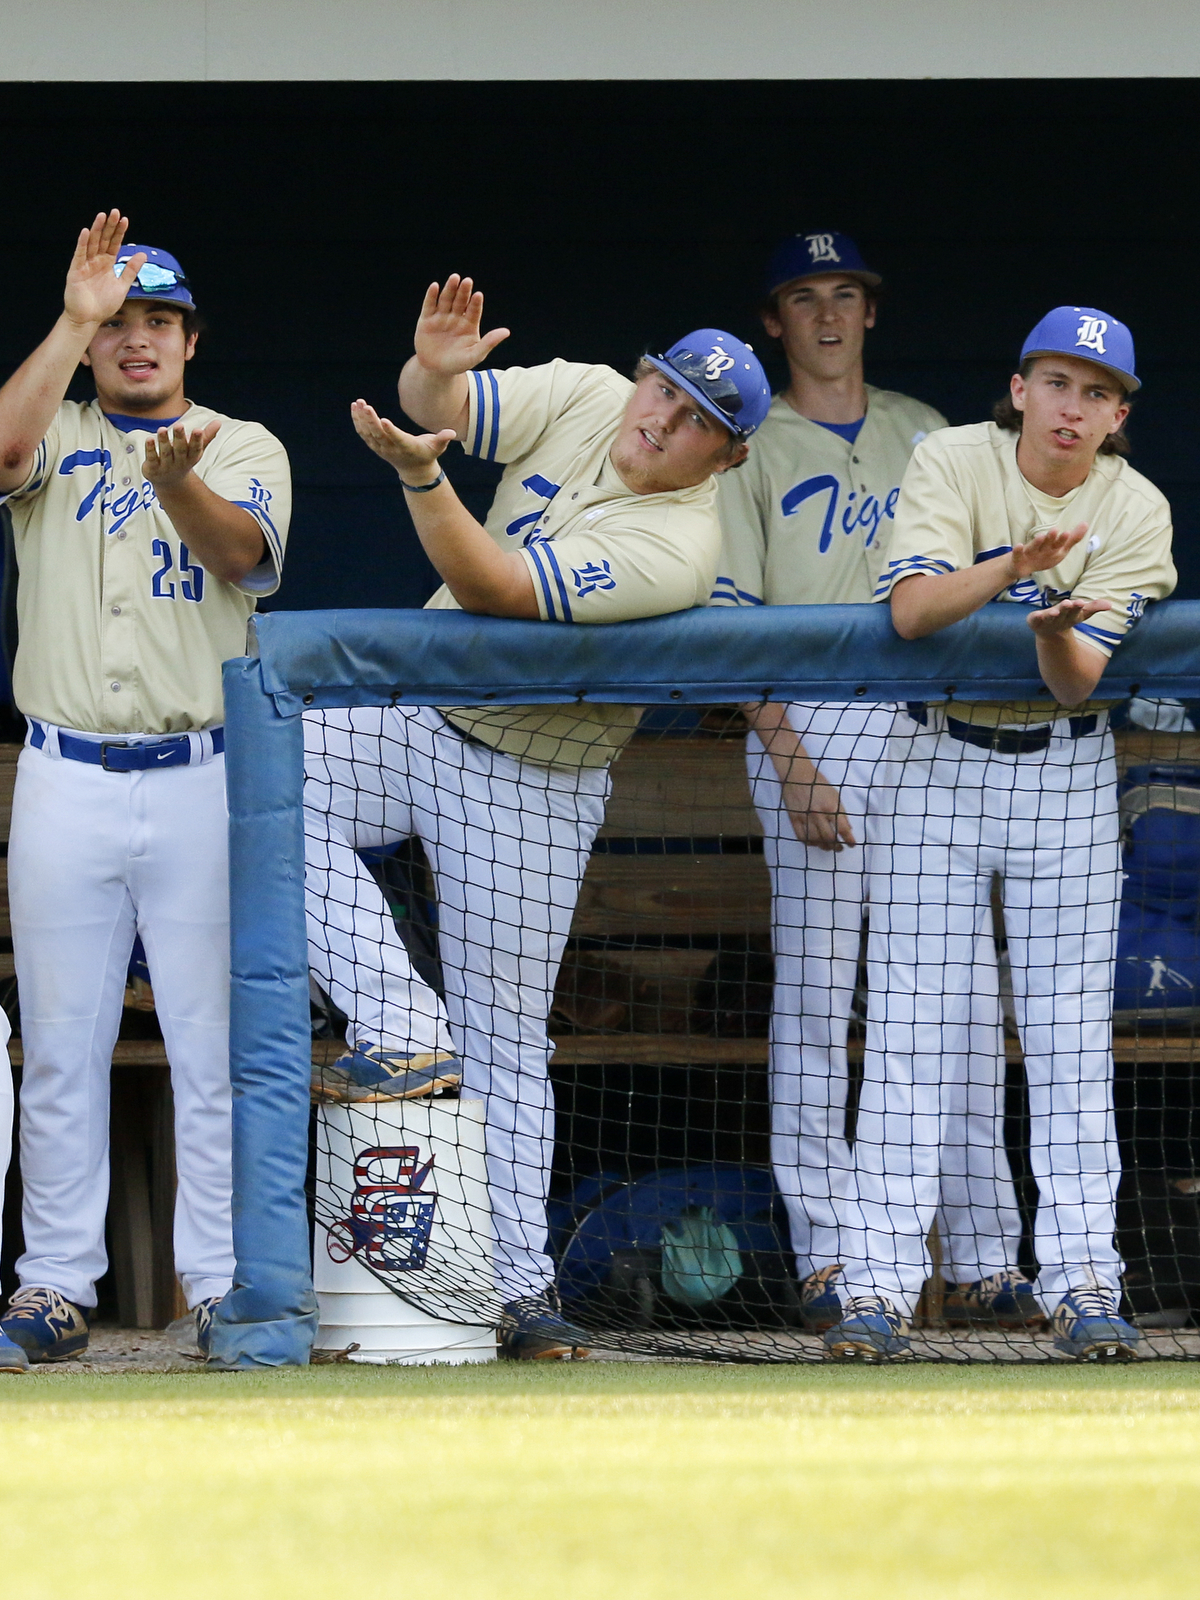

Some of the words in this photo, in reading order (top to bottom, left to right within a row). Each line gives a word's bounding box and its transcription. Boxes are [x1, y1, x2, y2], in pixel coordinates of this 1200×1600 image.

[804, 233, 841, 263] R
[1075, 315, 1108, 355] R
[780, 473, 902, 554] Tige
[150, 537, 205, 604] 25
